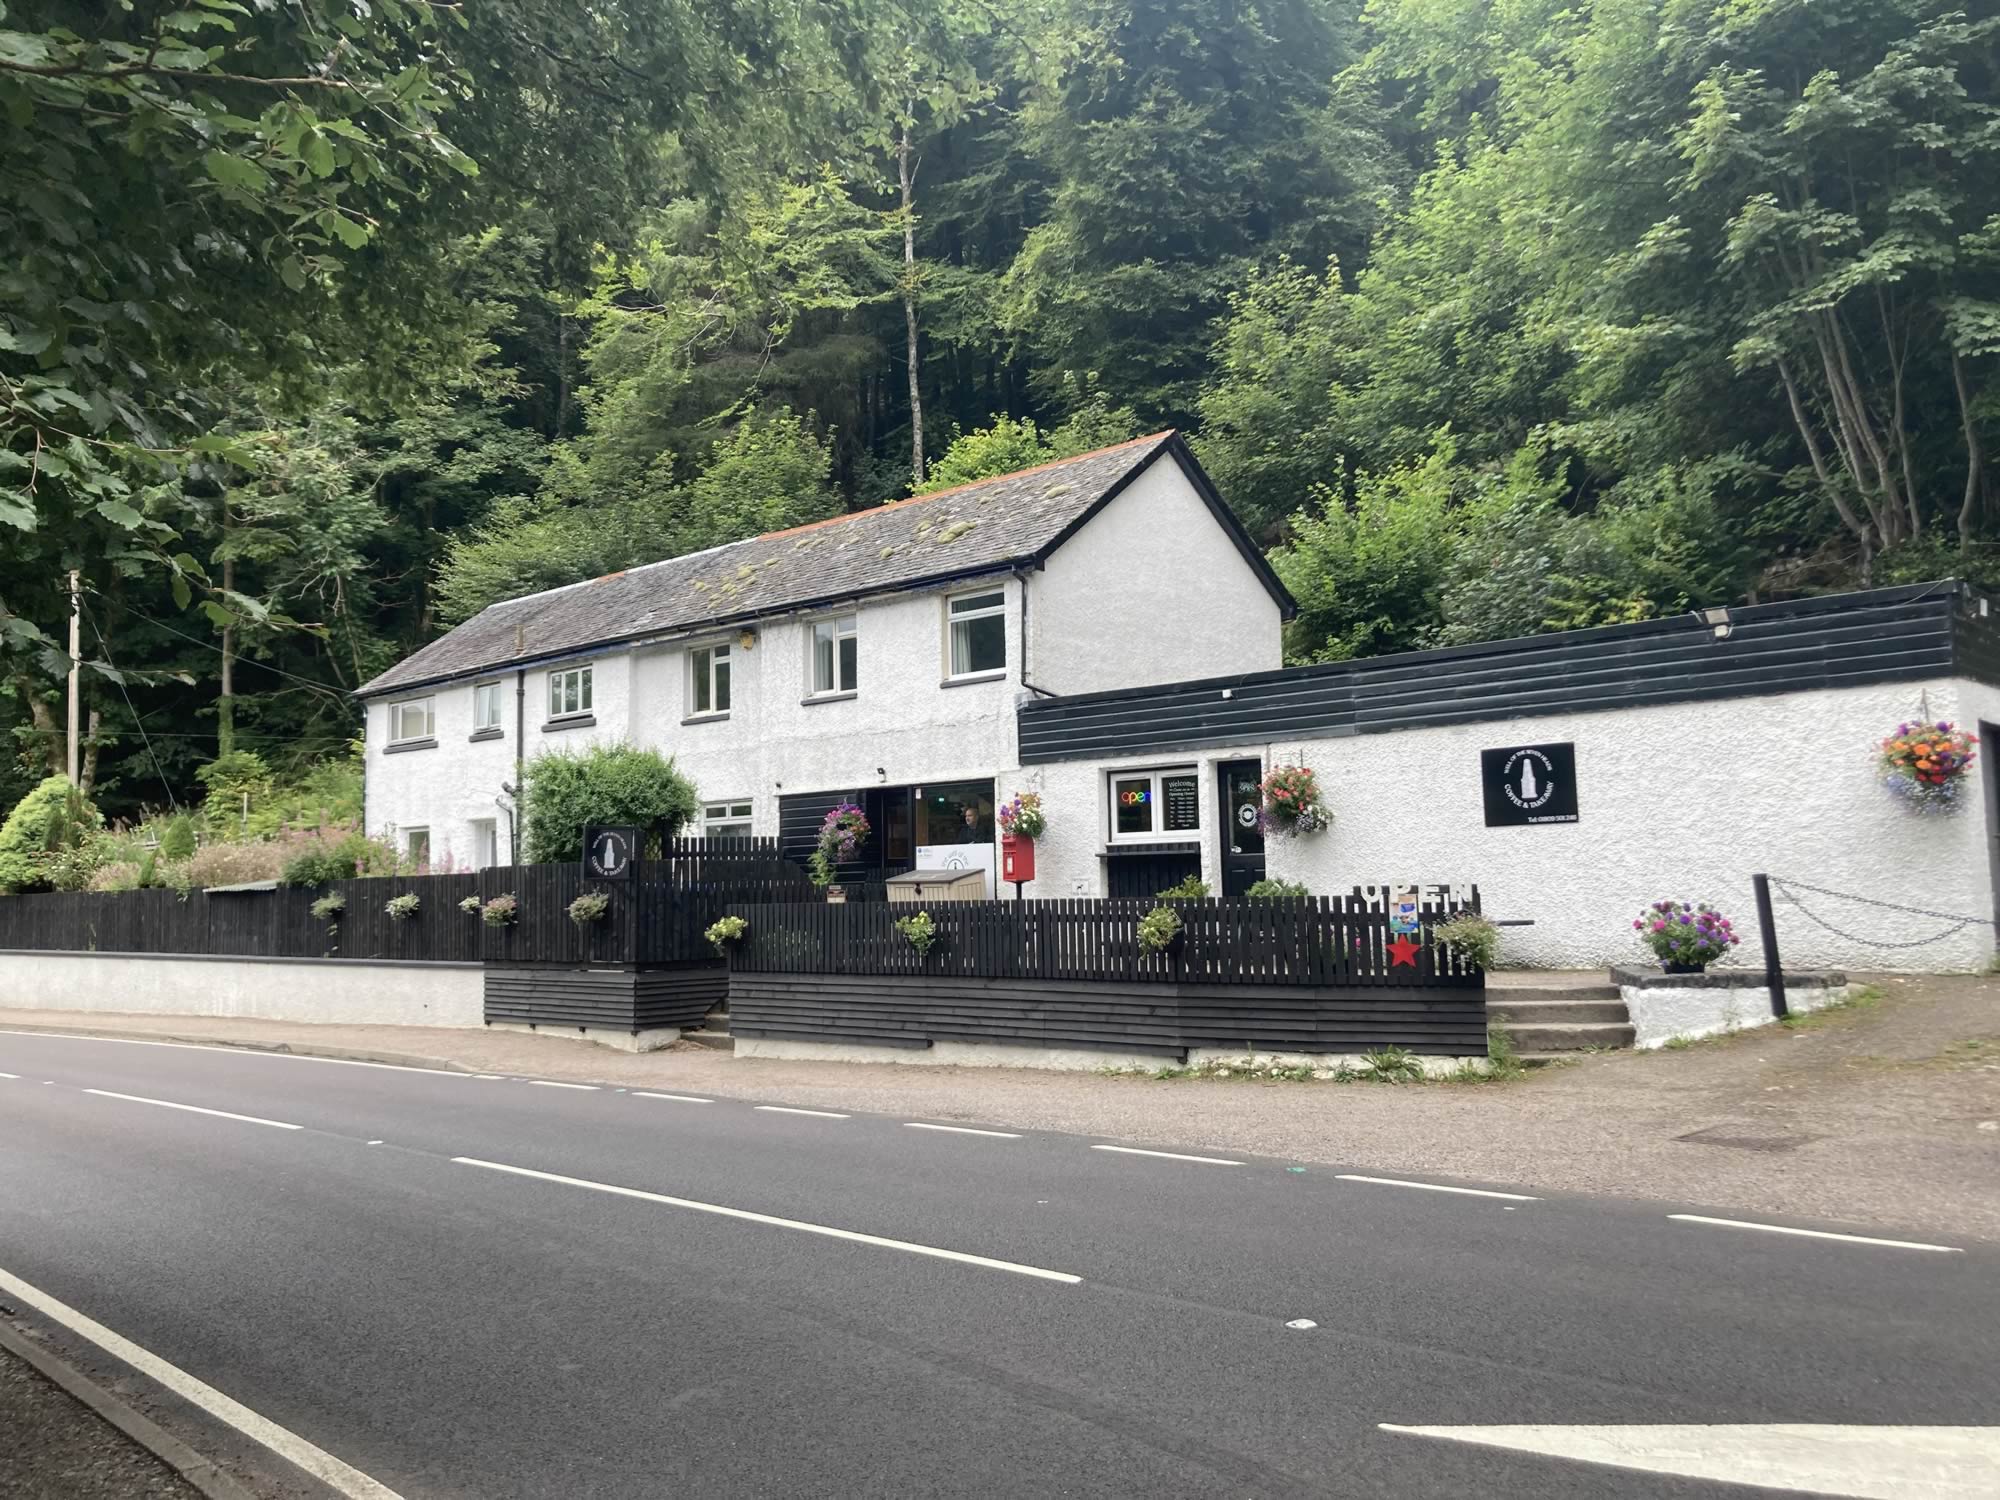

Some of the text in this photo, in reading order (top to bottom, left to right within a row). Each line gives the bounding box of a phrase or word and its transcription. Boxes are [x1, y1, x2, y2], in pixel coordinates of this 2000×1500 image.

[1168, 780, 1196, 788] Welcome
[1120, 791, 1152, 805] open
[1504, 783, 1523, 807] COFFEE
[1529, 780, 1554, 808] TAKEAWAY
[1360, 879, 1472, 904] OPEN
